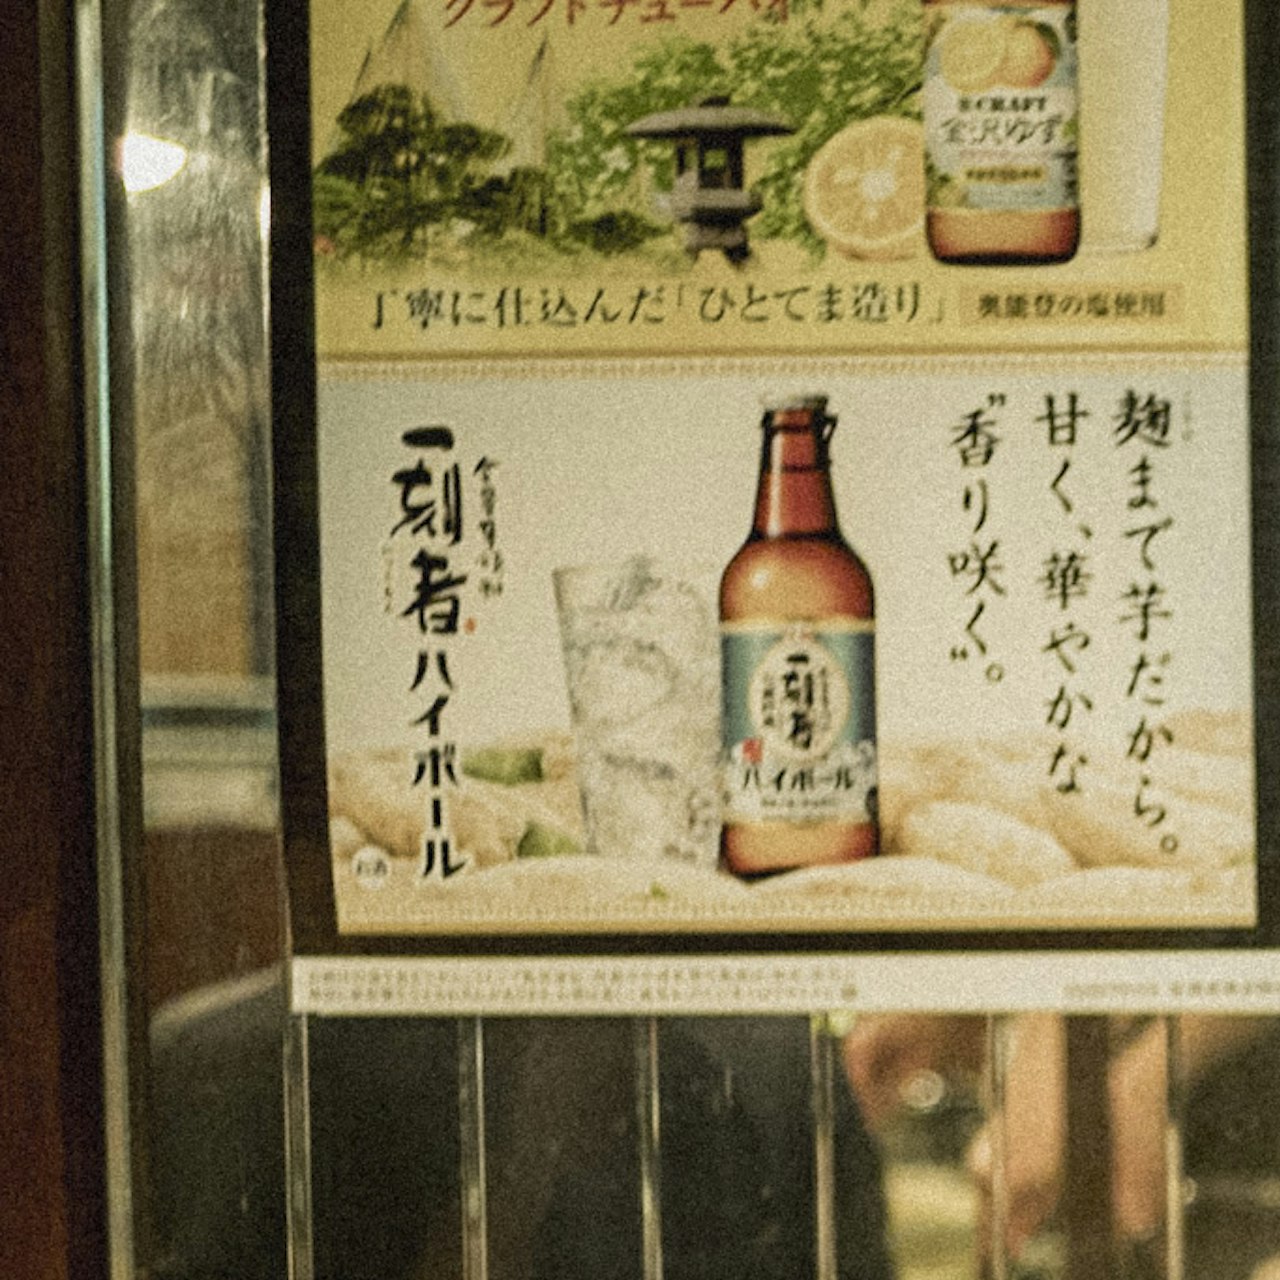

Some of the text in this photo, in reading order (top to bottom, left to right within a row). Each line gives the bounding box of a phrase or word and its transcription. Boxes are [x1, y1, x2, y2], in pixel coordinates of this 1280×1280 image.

[743, 767, 855, 791] ハイボール
[1035, 392, 1093, 795] 甘く、華やかな
[1113, 390, 1178, 855] 麹まで芋だから。
